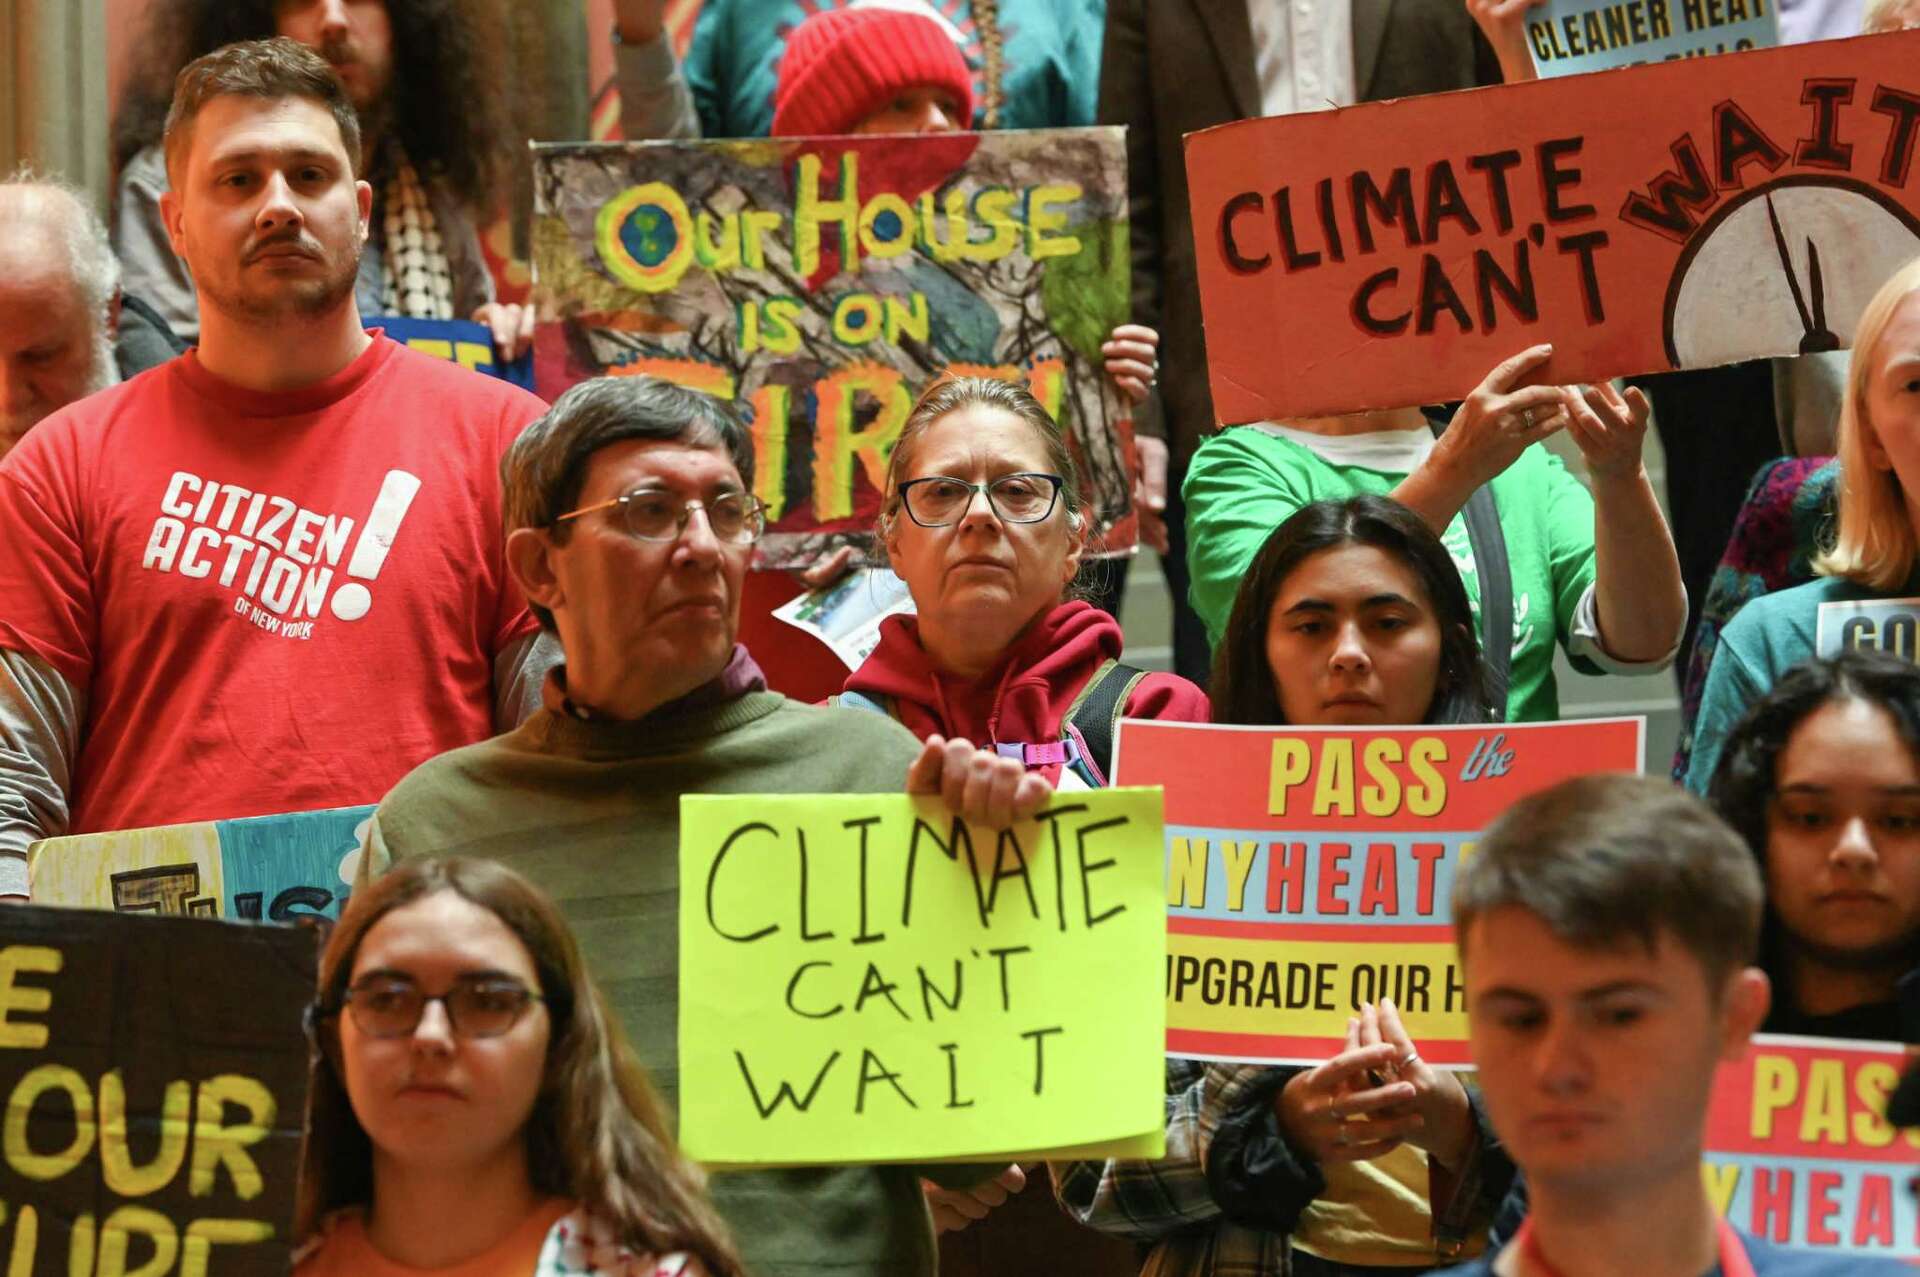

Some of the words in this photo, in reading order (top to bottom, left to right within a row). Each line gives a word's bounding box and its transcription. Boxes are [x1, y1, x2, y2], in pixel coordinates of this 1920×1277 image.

[1529, 0, 1671, 62] CLEANER
[1216, 134, 1597, 277] CLIMATE
[1618, 77, 1920, 245] WAIT
[735, 297, 802, 355] IS
[831, 292, 932, 347] ON
[1349, 222, 1609, 337] CAN'T
[160, 471, 355, 567] CITIZEN
[142, 516, 334, 619] ACTION
[233, 596, 251, 617] OF
[249, 608, 279, 632] NEW
[281, 620, 316, 640] YORK
[1267, 737, 1449, 817] PASS
[1460, 734, 1516, 782] the
[706, 803, 1130, 945] CLIMATE
[785, 945, 1033, 1022] CAN'T
[1350, 963, 1431, 1013] OUR
[734, 1026, 1064, 1120] WAIT
[1751, 1054, 1920, 1150] PAS
[3, 1063, 278, 1200] OUR
